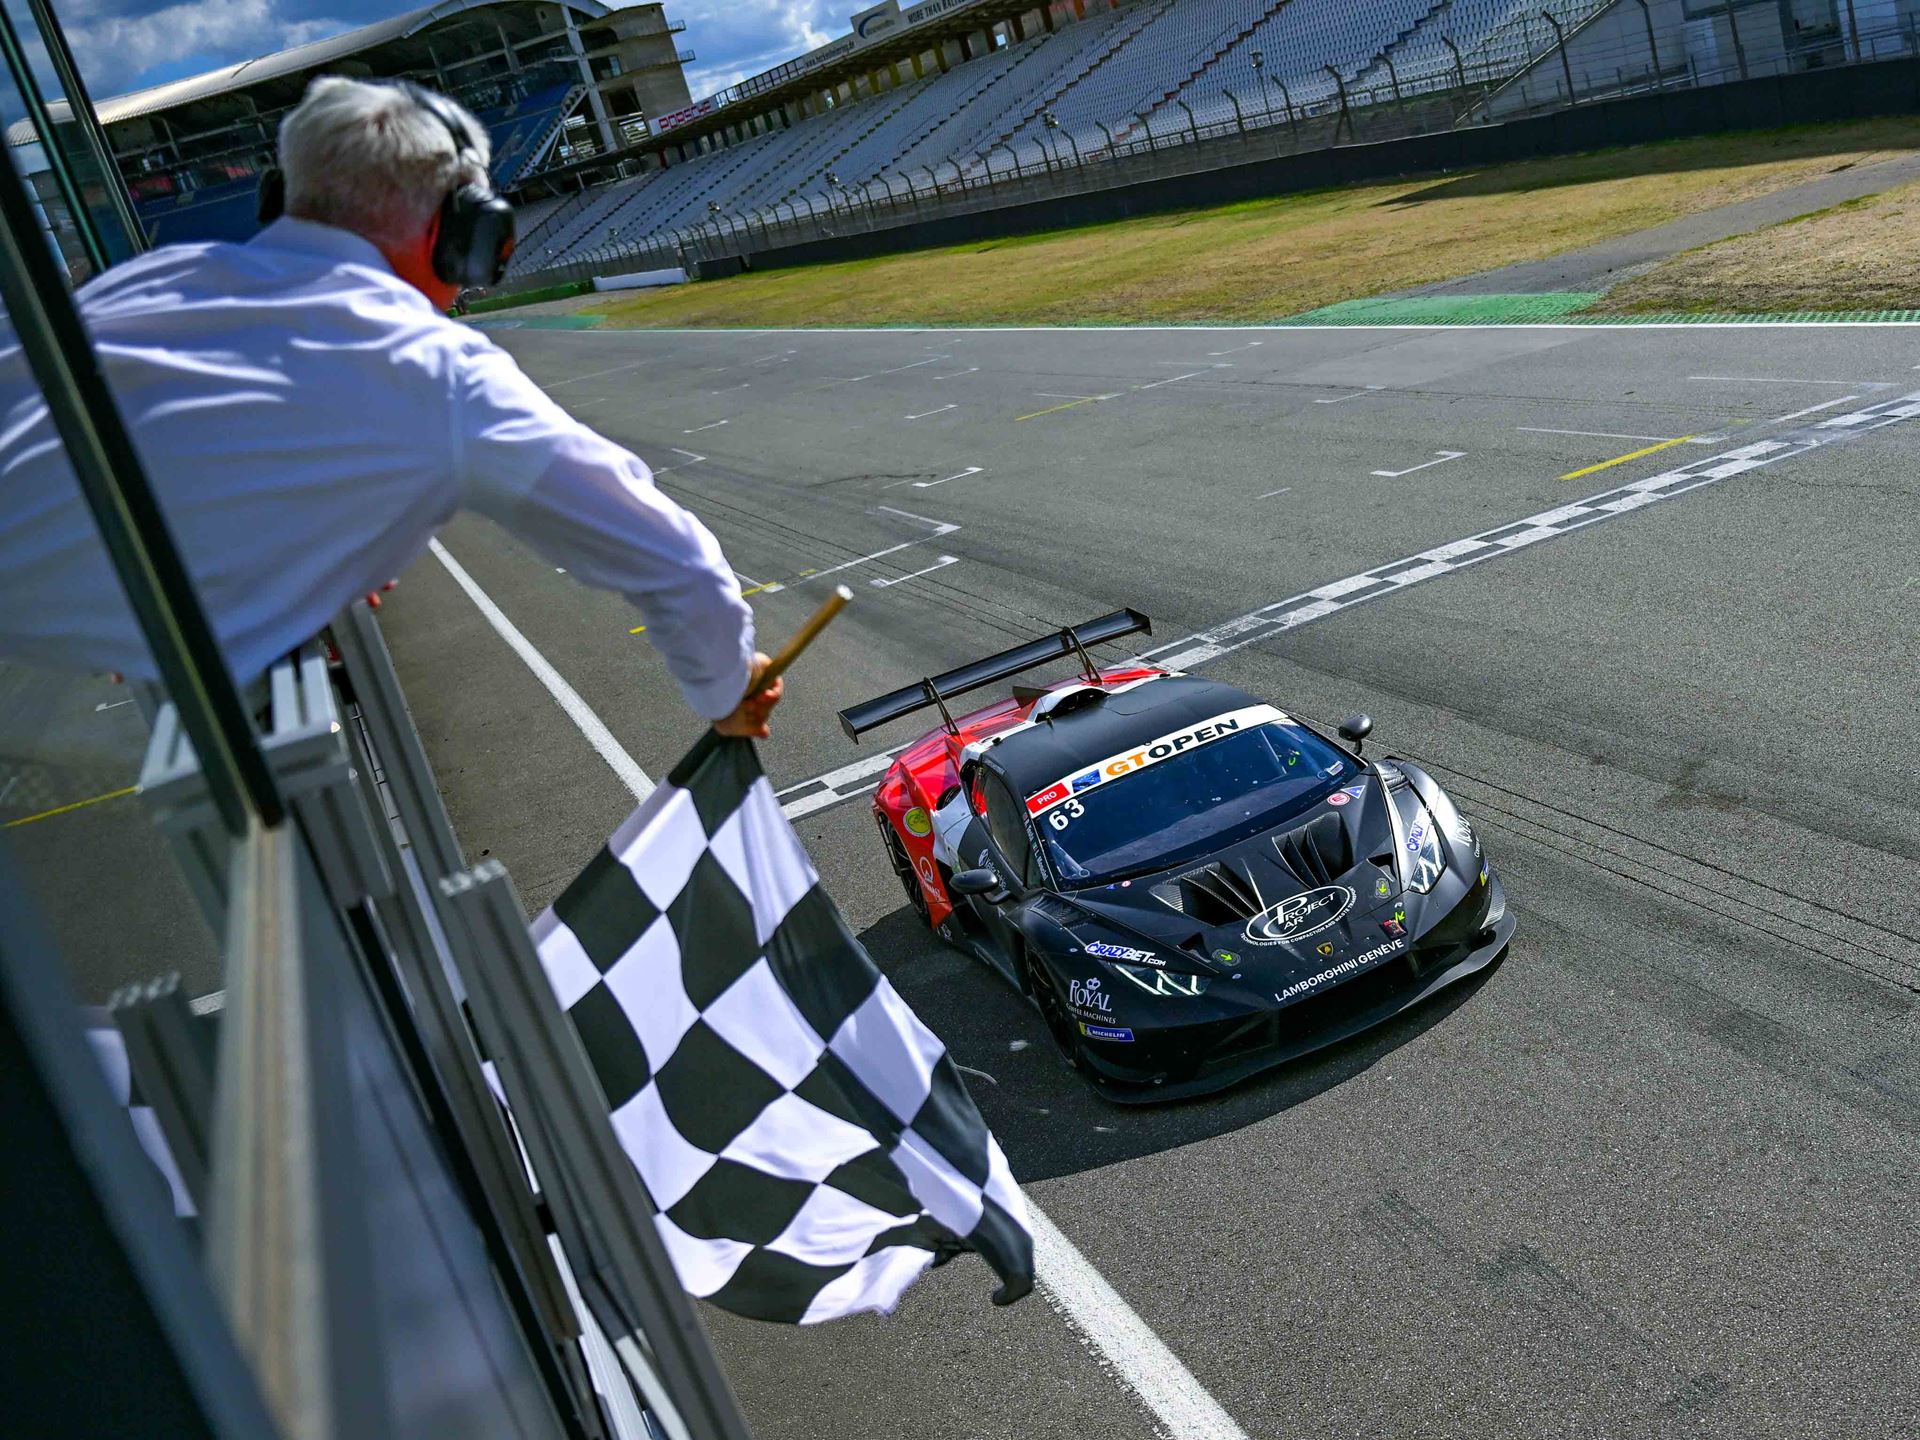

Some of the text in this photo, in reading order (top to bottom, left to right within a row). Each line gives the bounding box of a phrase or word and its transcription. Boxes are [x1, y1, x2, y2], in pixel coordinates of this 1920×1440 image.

[1036, 790, 1057, 805] PRO
[1048, 797, 1085, 831] 63
[1276, 891, 1336, 925] PROJECT
[1290, 927, 1326, 944] COMPACTION
[1325, 920, 1336, 930] AND
[1335, 907, 1350, 924] WASTE
[1274, 938, 1405, 1002] LAMBORGHINI GENÈVE
[1069, 979, 1113, 1012] ROYAL
[1083, 1009, 1117, 1024] MACHINES
[1092, 1030, 1125, 1038] MICHELIN
